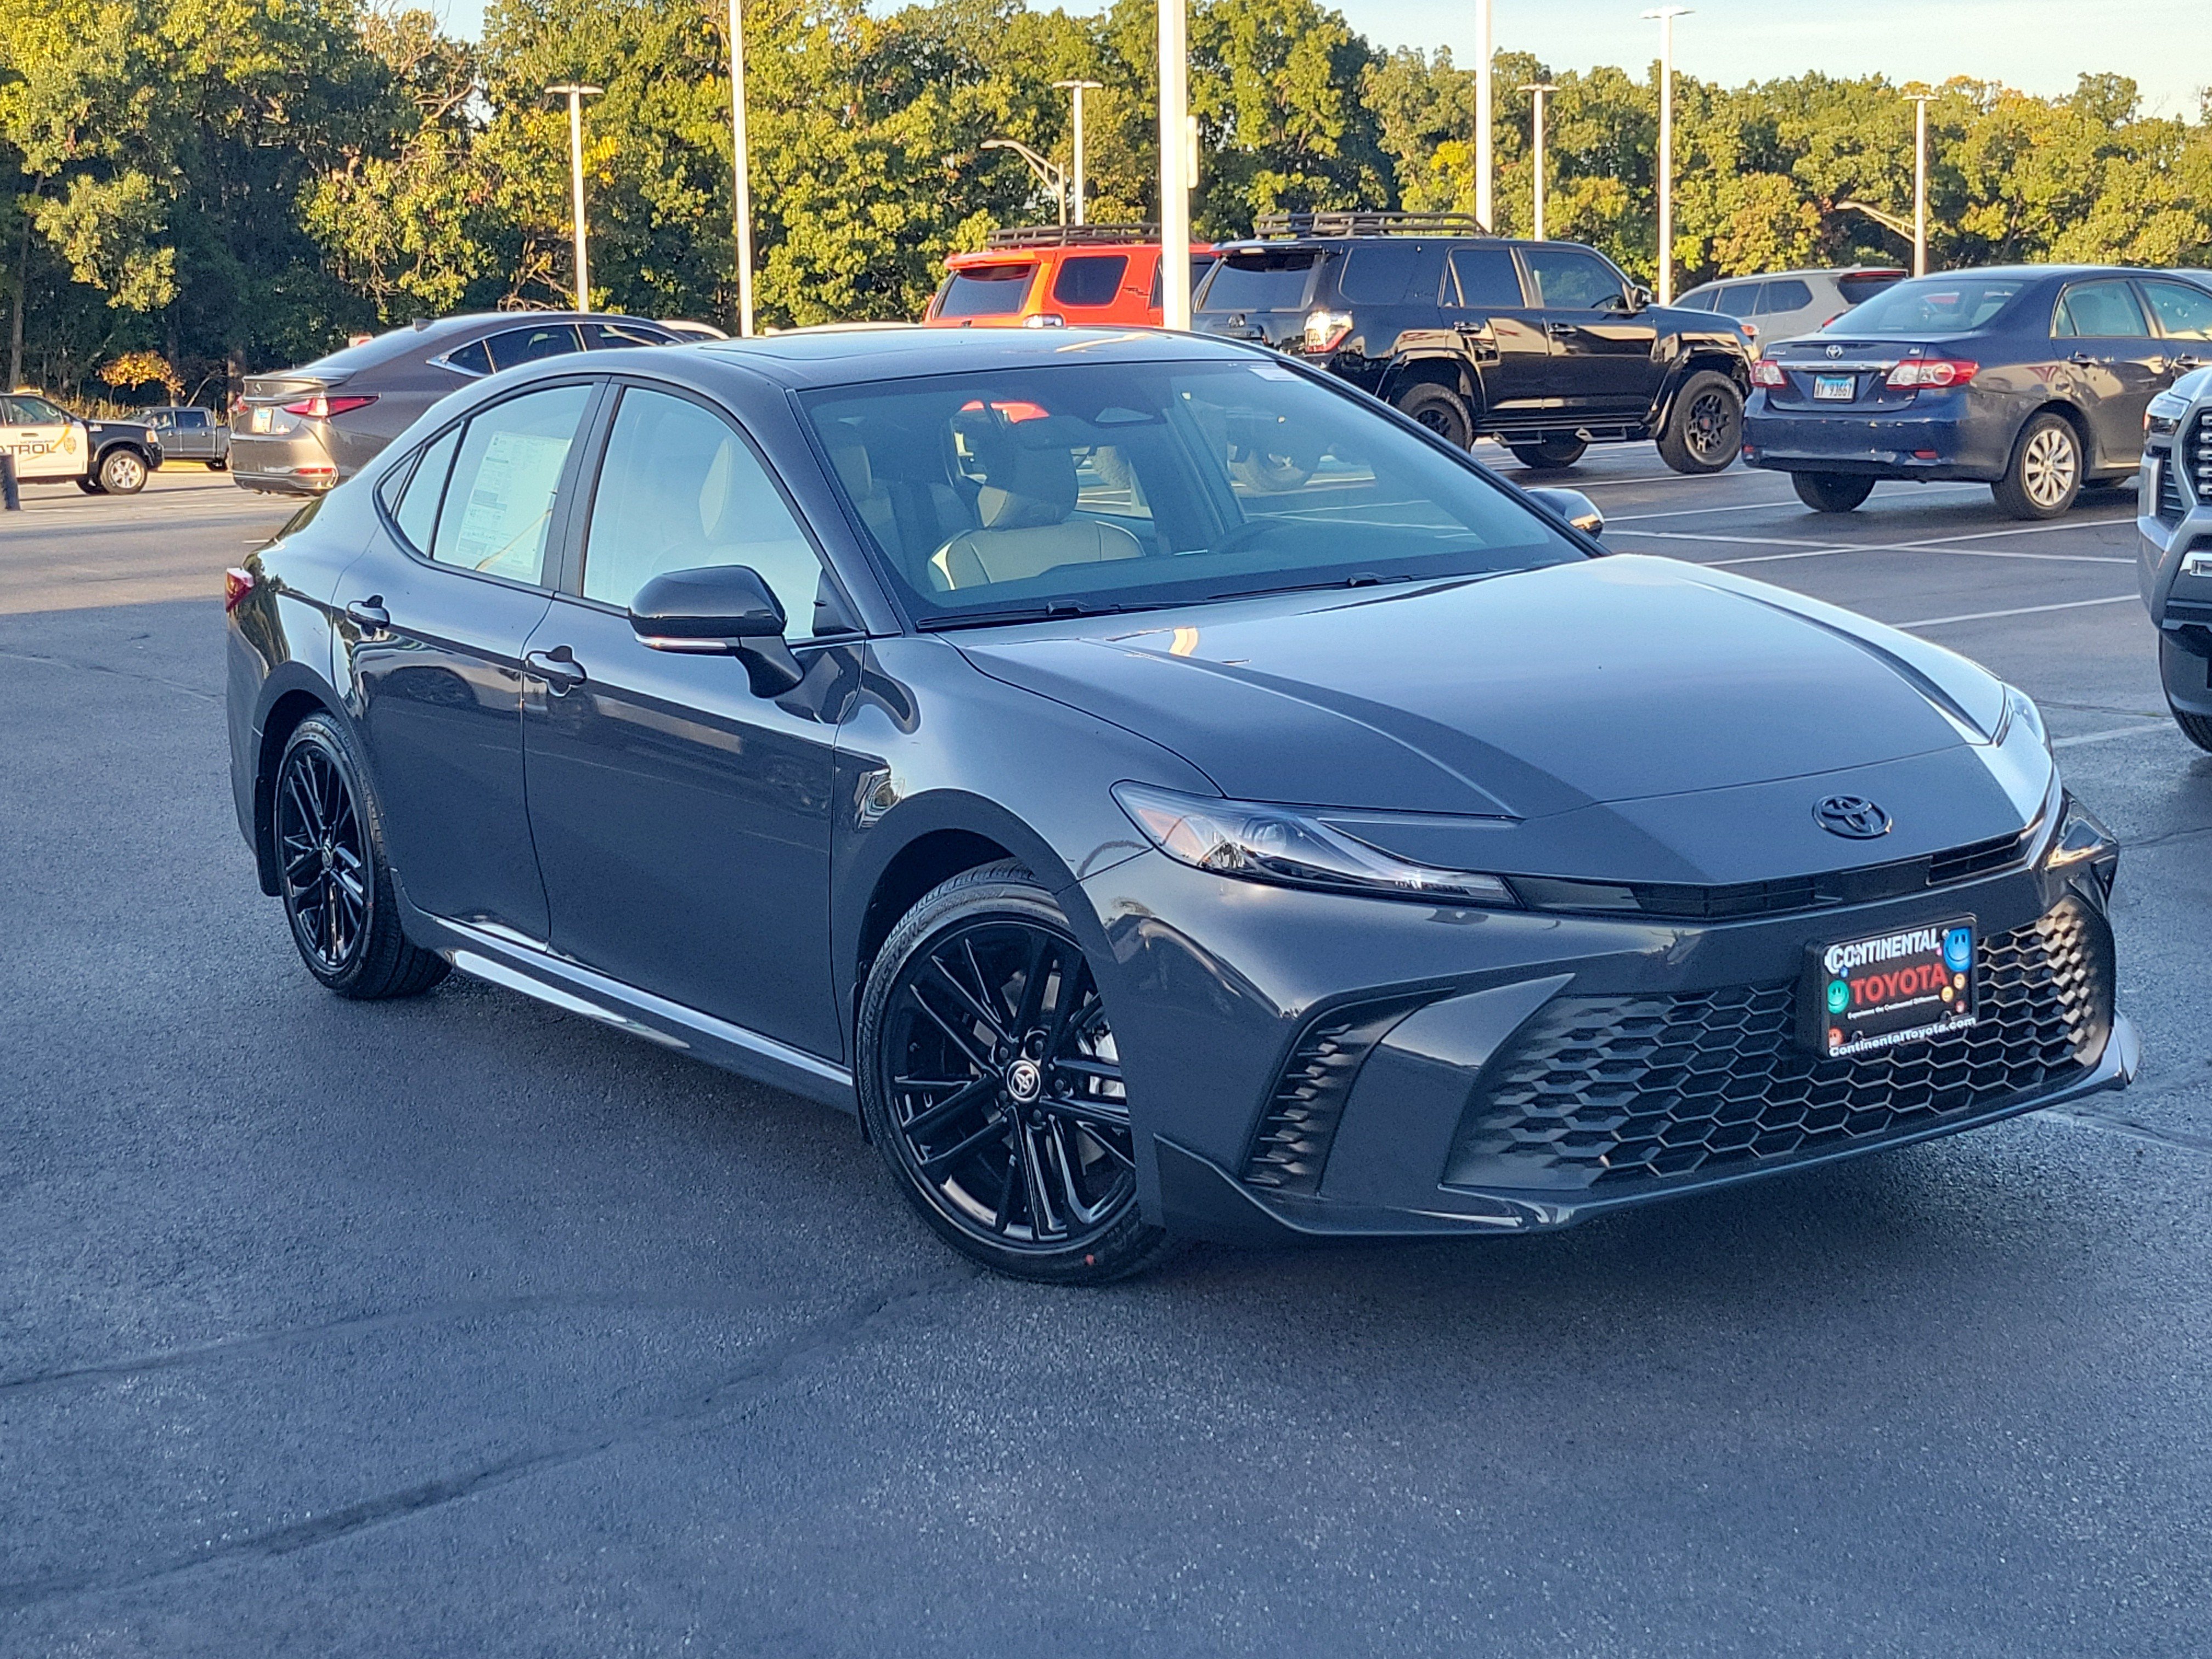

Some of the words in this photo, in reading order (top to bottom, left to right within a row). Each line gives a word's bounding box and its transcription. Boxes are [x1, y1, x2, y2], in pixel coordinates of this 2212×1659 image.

[1824, 928, 1940, 974] CONTINENTAL
[1850, 963, 1948, 1005] TOYOTA
[1829, 1016, 1976, 1057] ContinentalToyota.com
